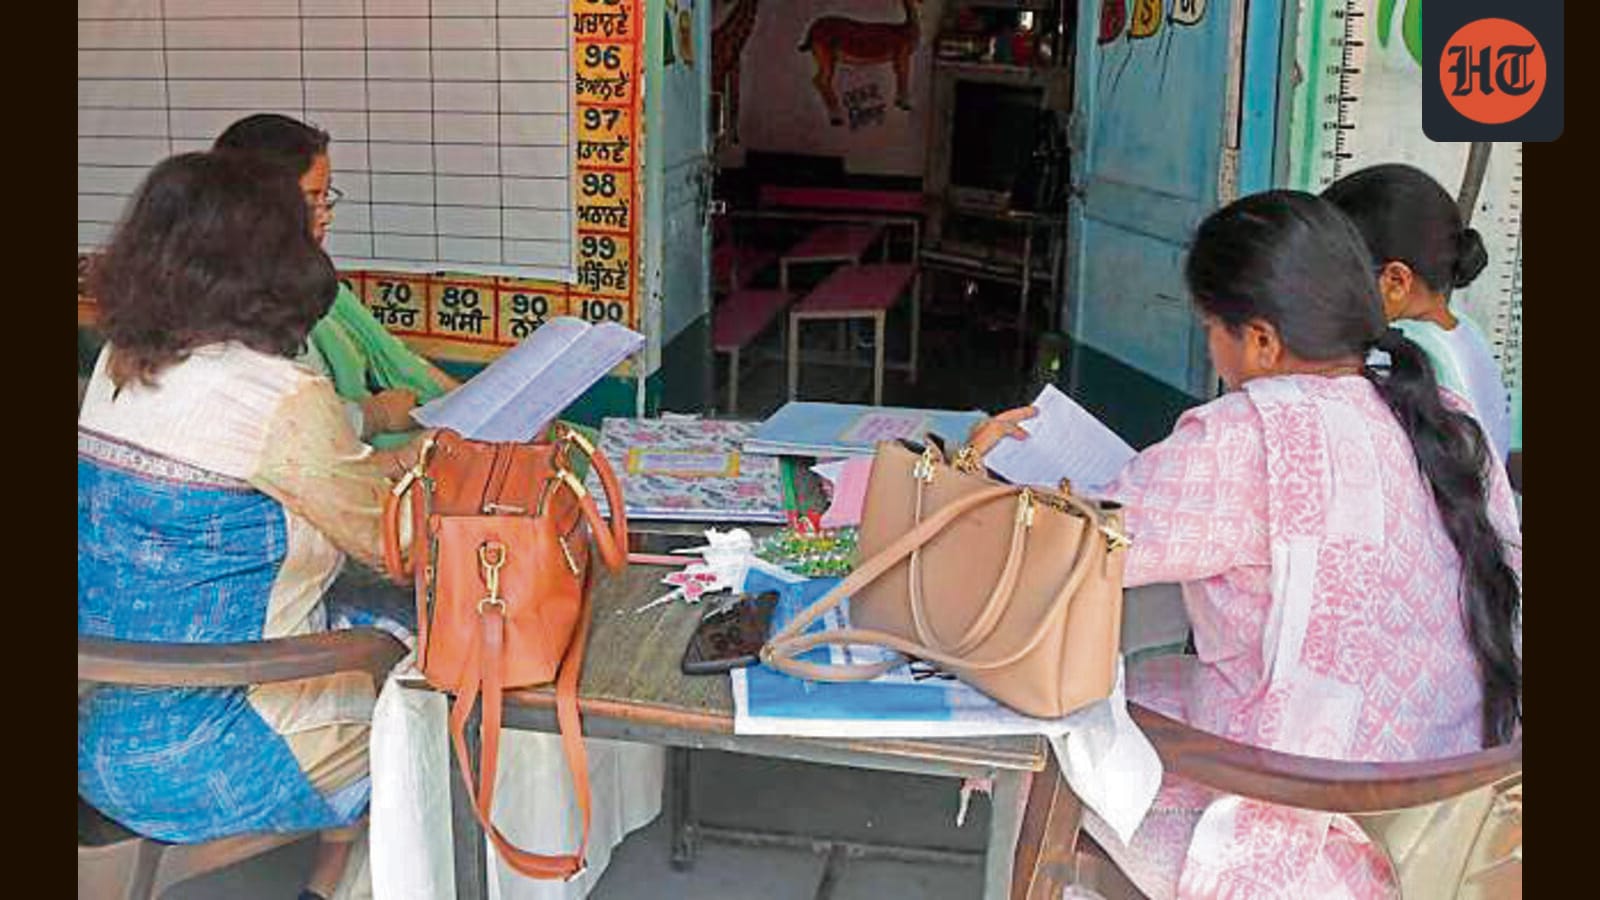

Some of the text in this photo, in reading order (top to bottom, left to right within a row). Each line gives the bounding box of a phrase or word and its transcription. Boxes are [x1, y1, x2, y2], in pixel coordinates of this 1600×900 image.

[584, 44, 621, 69] 96
[584, 108, 620, 131] 97
[582, 173, 616, 198] 98
[580, 236, 617, 260] 99
[376, 281, 412, 303] 70
[442, 287, 479, 308] 80
[511, 293, 548, 316] 90
[582, 300, 623, 322] 100
